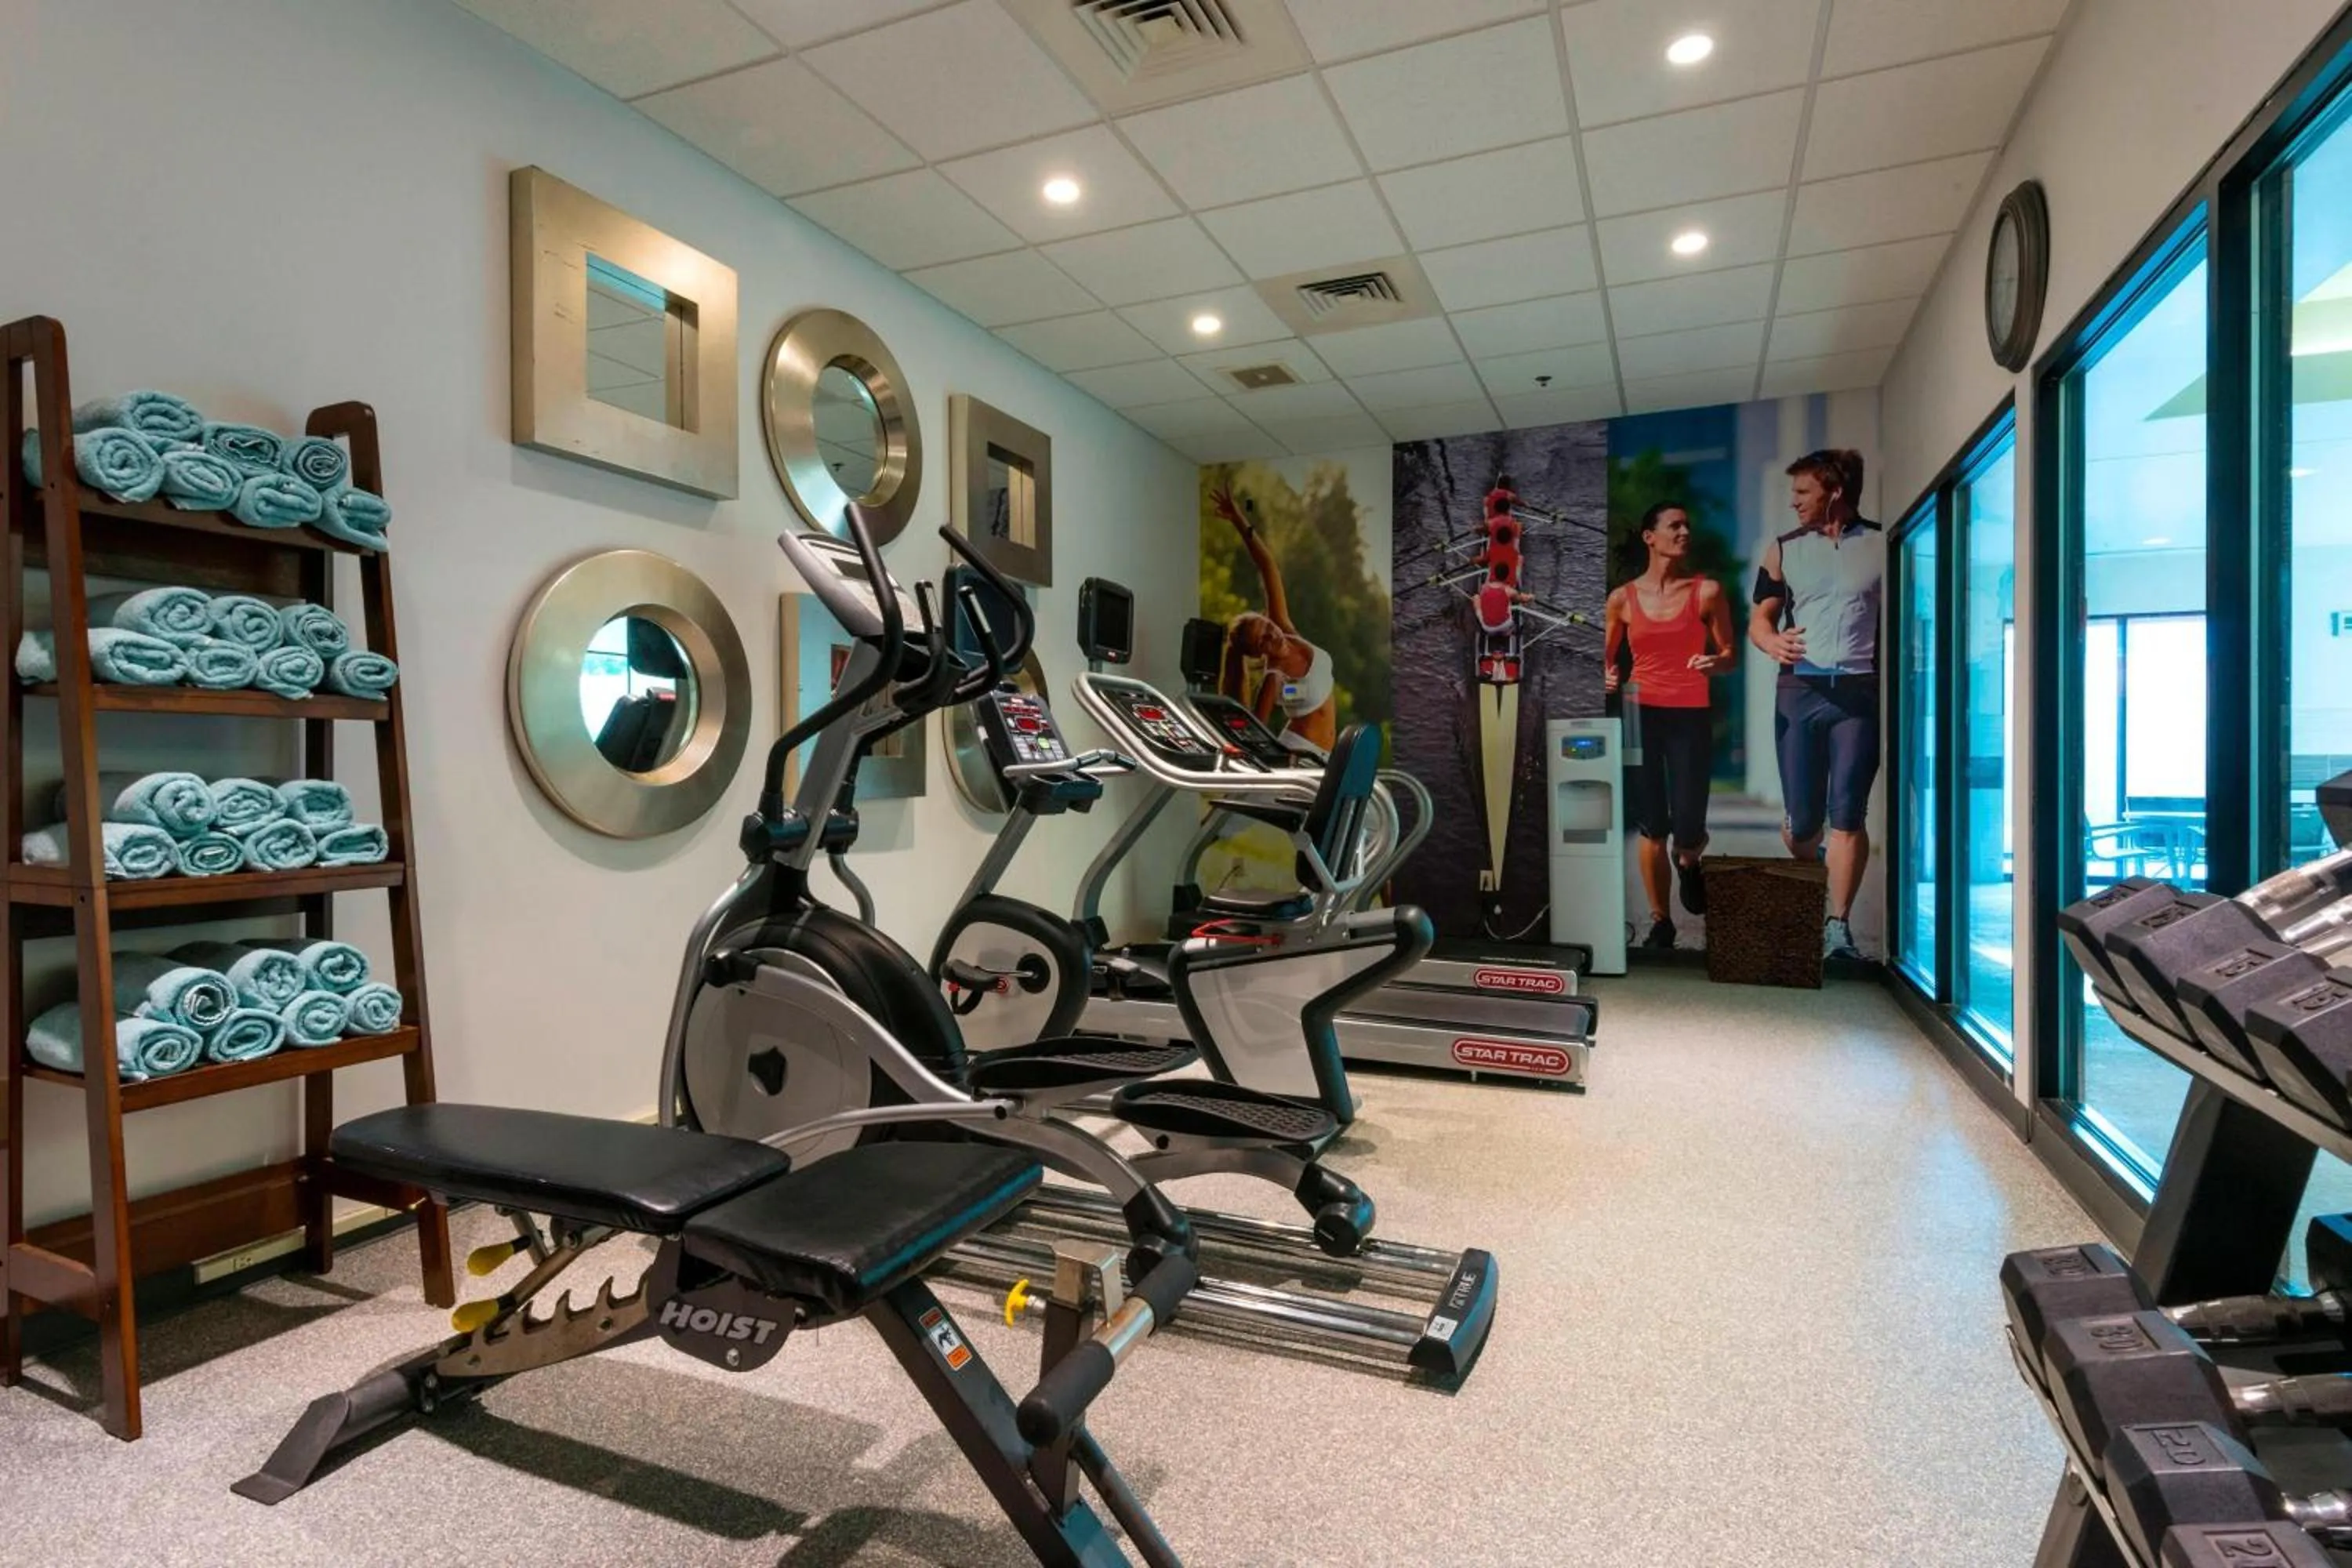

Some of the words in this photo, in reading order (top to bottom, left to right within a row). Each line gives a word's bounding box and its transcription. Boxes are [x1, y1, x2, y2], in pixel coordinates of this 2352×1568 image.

[1480, 975, 1515, 985] STAR
[1518, 979, 1556, 989] TRAC
[1461, 1047, 1505, 1061] STAR
[1508, 1051, 1559, 1066] TRAC
[659, 1301, 777, 1344] HOIST
[2091, 1324, 2144, 1350] 30
[2152, 1428, 2206, 1466] 20
